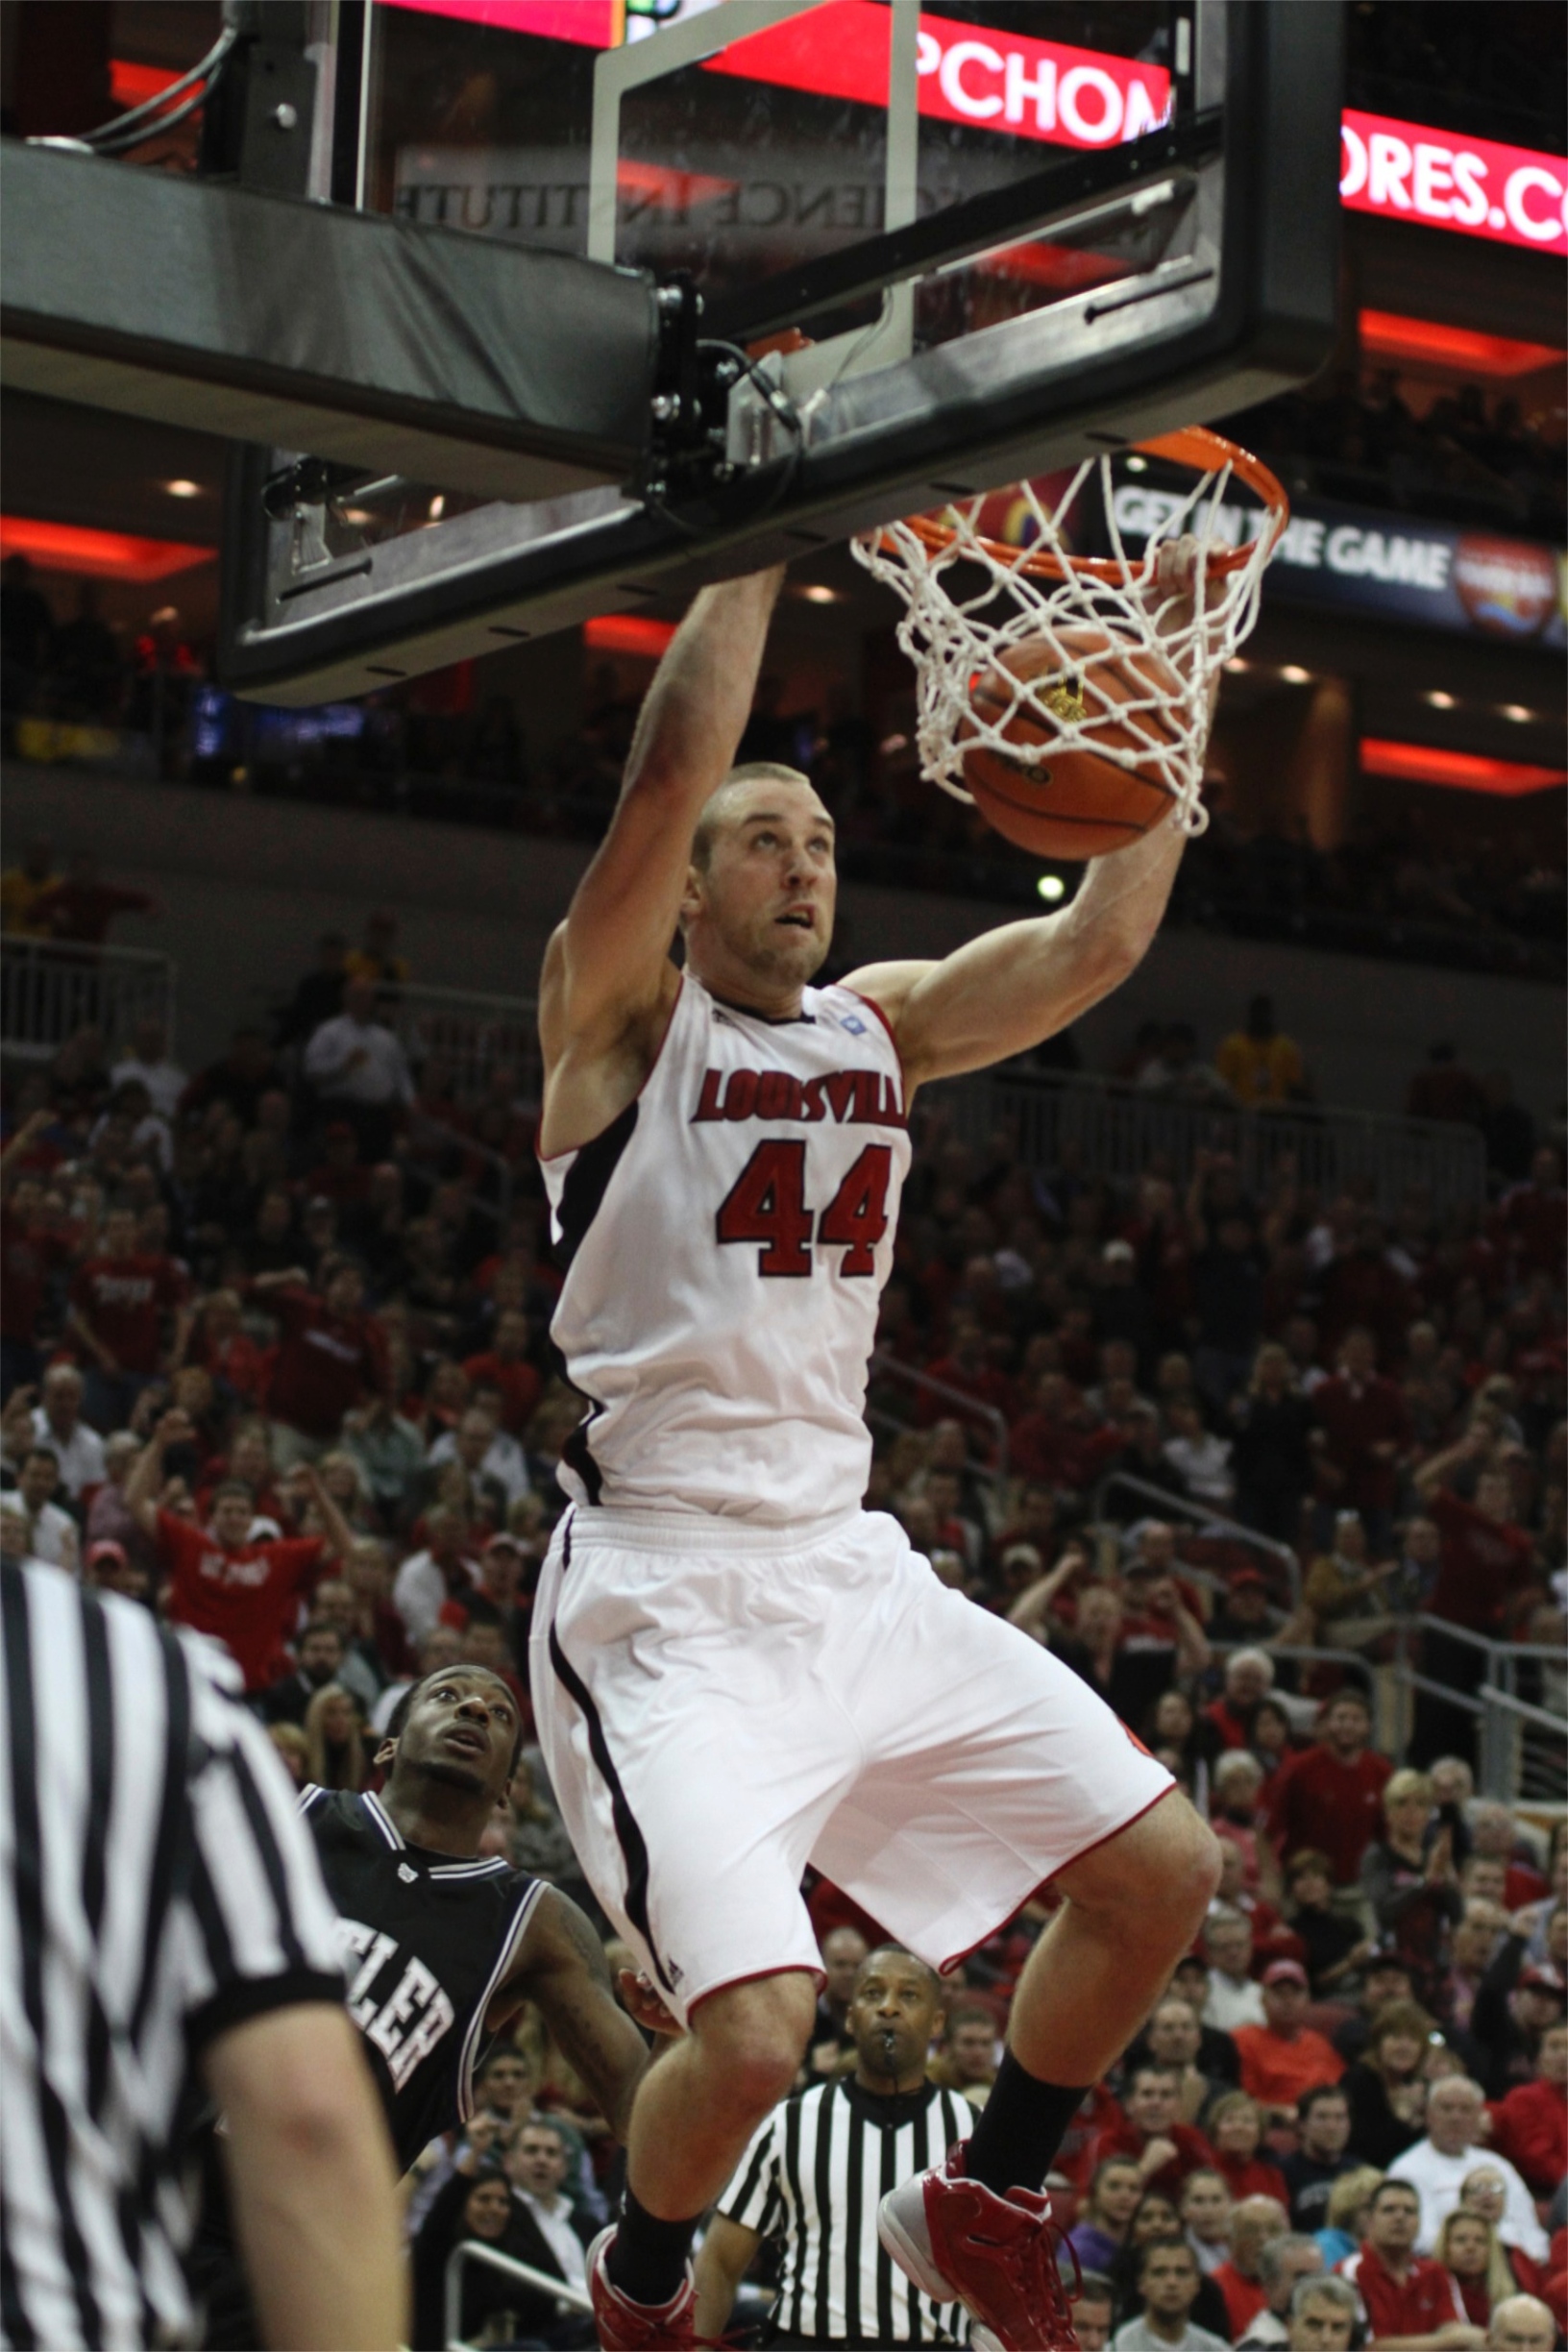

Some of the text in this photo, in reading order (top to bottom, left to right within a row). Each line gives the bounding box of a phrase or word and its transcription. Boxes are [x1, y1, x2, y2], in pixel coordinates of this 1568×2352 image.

[1340, 125, 1568, 240] RES.C
[1112, 484, 1188, 540] GET
[1327, 526, 1452, 591] GAME
[715, 1139, 894, 1278] 44
